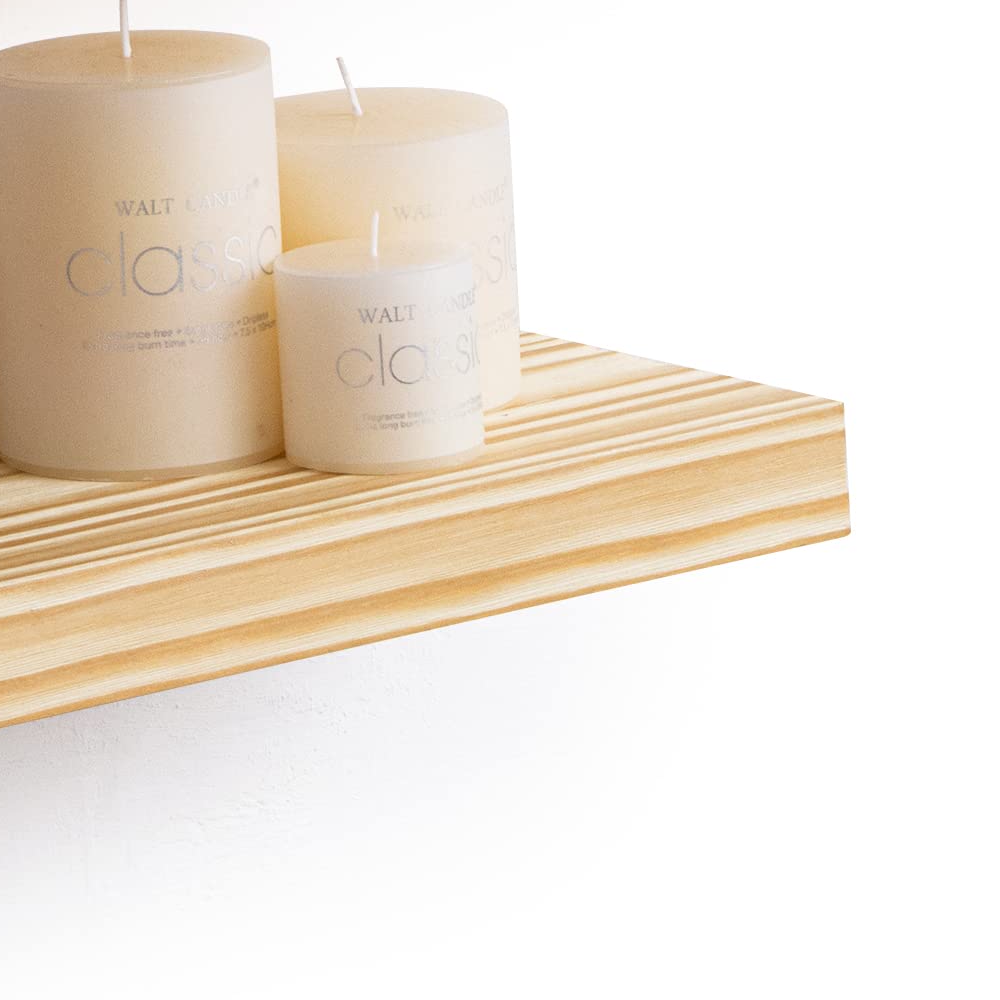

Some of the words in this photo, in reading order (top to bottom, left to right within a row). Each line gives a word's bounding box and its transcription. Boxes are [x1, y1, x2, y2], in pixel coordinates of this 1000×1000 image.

[114, 198, 175, 216] WALT
[392, 204, 447, 222] WAL
[66, 225, 277, 296] classic
[358, 305, 416, 324] WALT
